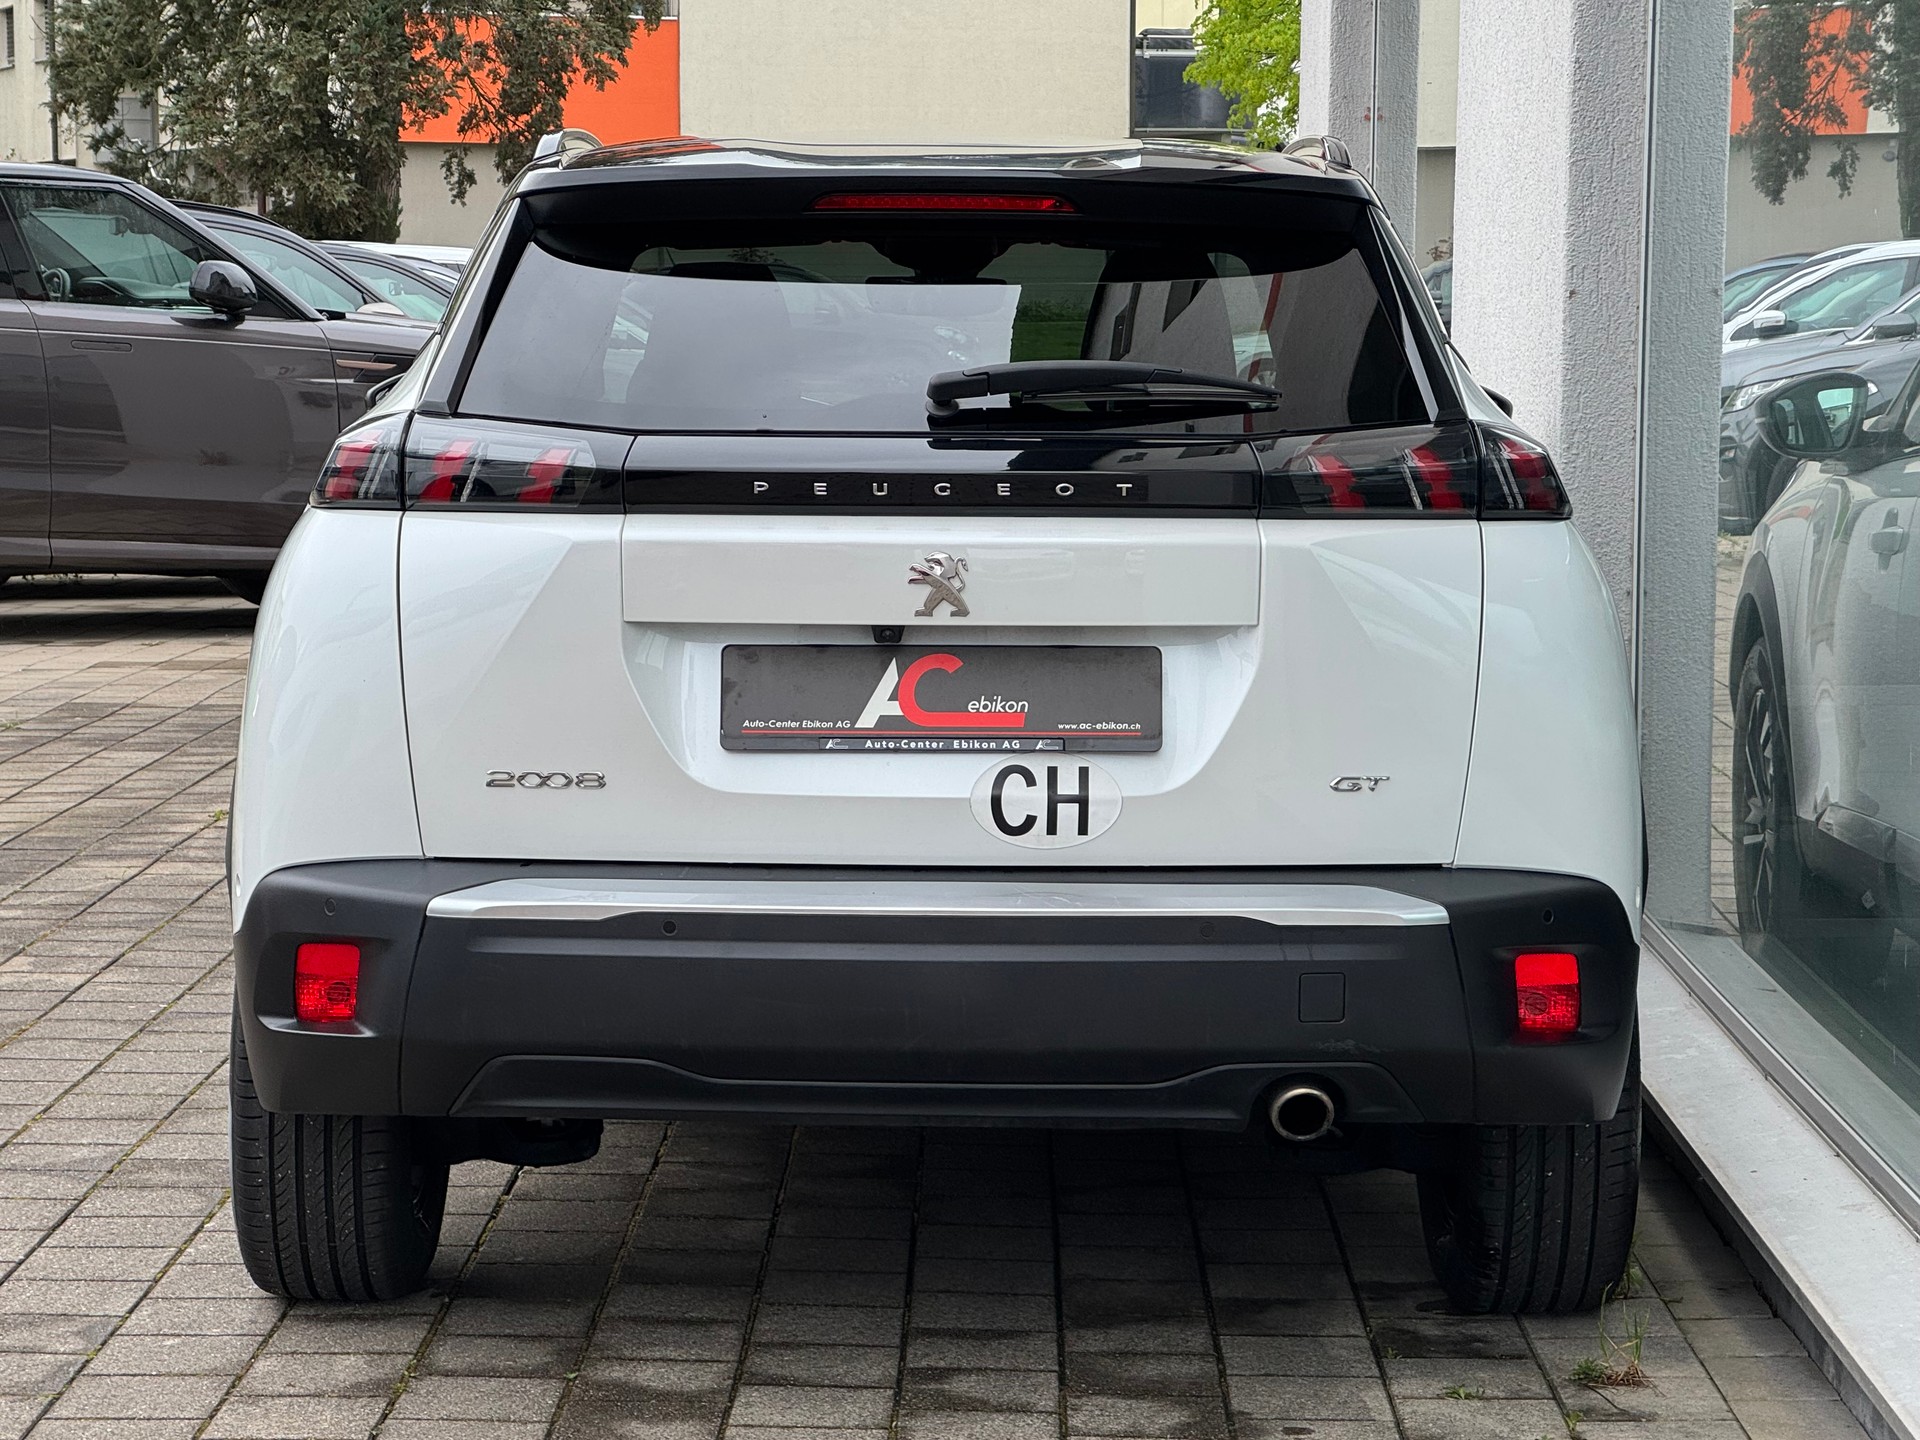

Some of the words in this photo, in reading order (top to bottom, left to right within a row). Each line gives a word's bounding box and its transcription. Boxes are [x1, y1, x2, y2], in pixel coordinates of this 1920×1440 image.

[753, 481, 1133, 497] PEUGEOT
[854, 653, 1026, 728] AC
[967, 696, 1029, 714] ebikon
[742, 719, 801, 729] Auto-Center
[802, 720, 834, 729] Ebikon
[836, 720, 851, 729] AG
[1057, 721, 1141, 731] www.ac-ebikon.ch
[864, 739, 944, 749] Auto-Center
[953, 739, 997, 749] Ebikon
[1002, 740, 1021, 749] AG
[485, 769, 607, 790] 2008
[1328, 775, 1391, 793] GT
[990, 764, 1090, 837] CH
